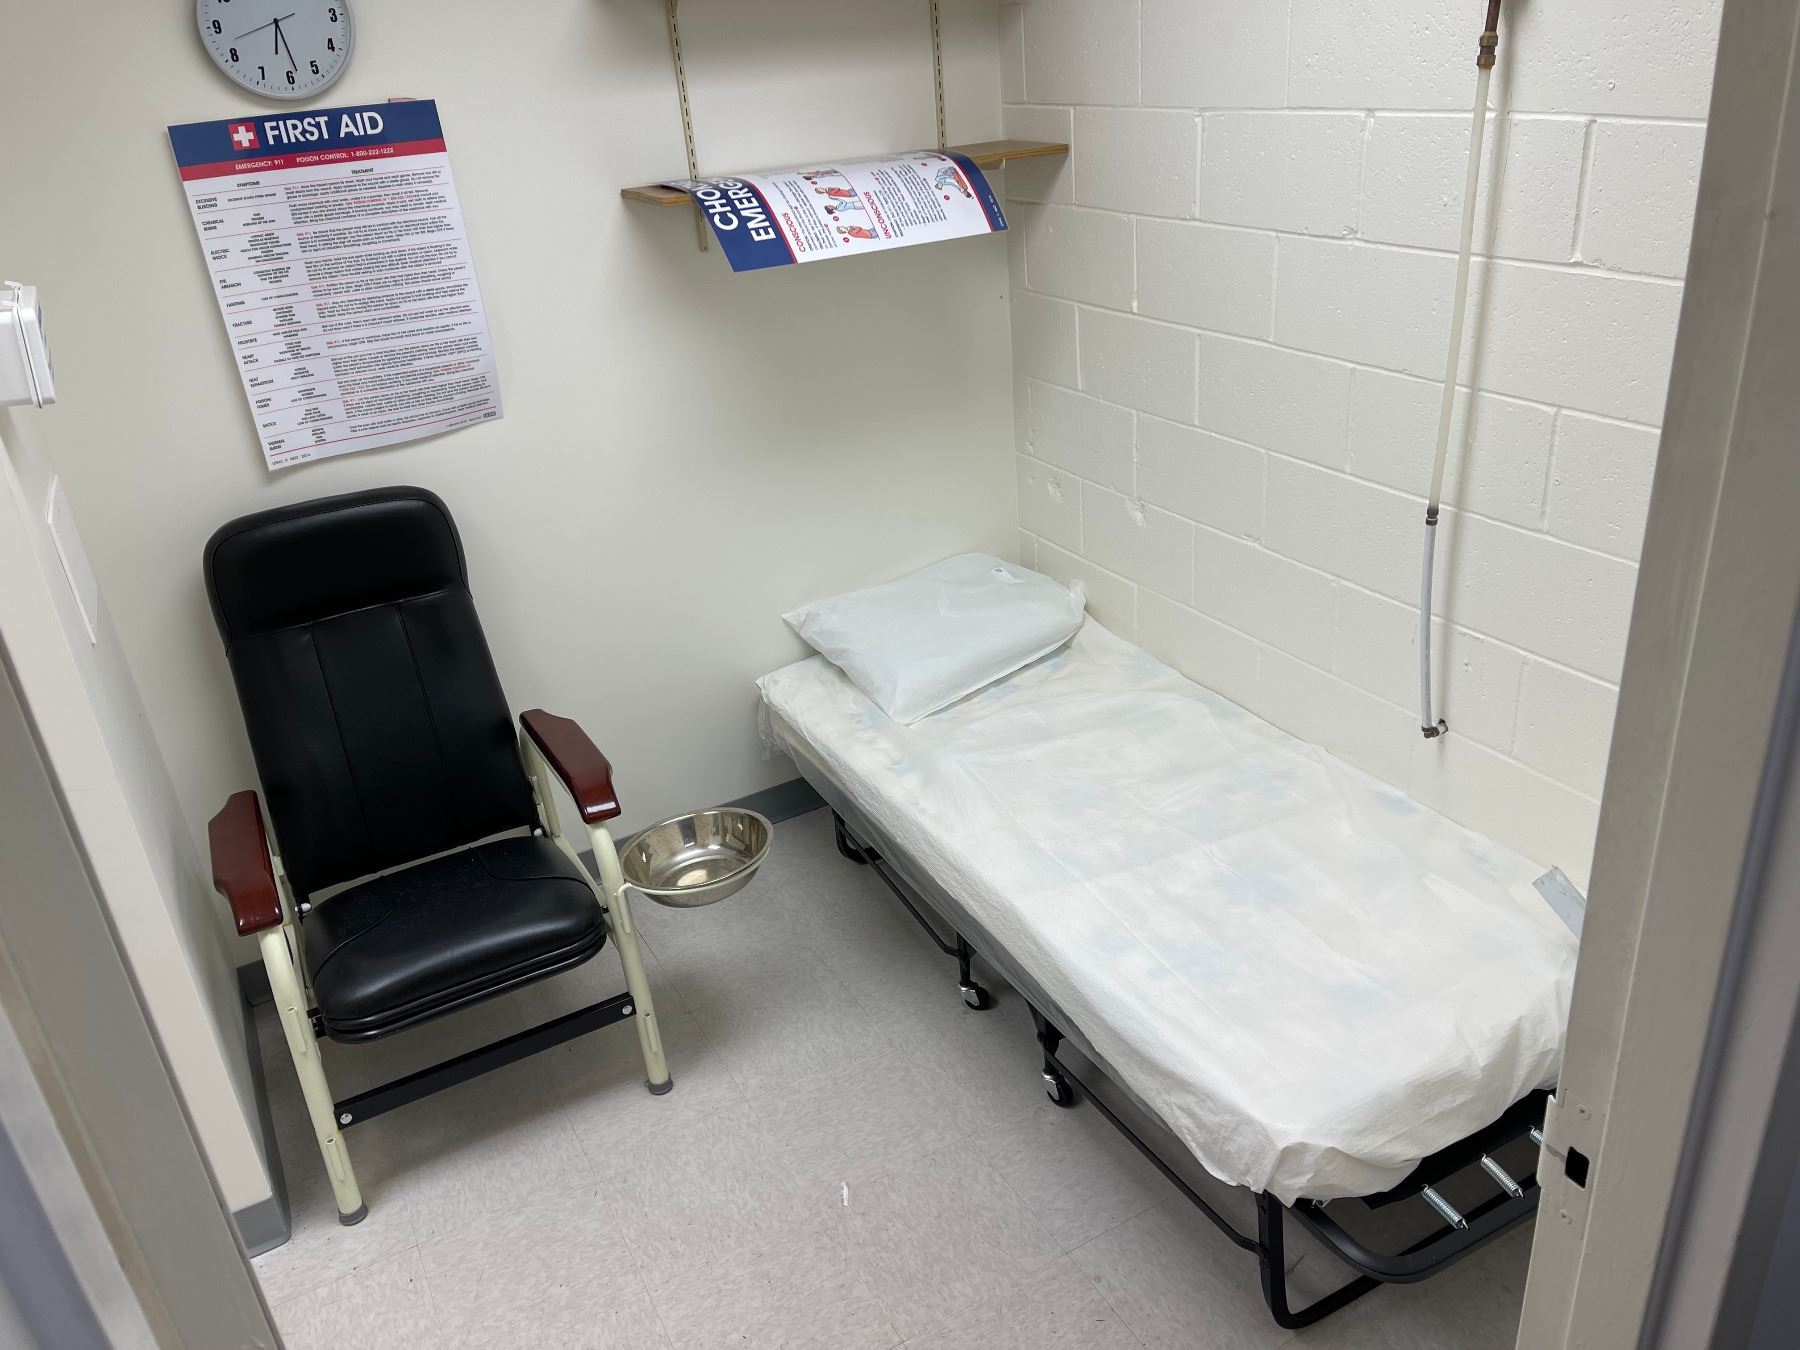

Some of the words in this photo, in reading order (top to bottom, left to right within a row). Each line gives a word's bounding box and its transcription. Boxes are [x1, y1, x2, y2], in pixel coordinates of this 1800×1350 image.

[328, 8, 338, 22] 3
[212, 19, 222, 34] 9
[327, 38, 335, 52] 4
[229, 48, 239, 62] 8
[258, 66, 266, 80] 7
[310, 60, 319, 74] 5
[286, 70, 295, 85] 6
[264, 116, 329, 144] FIRST
[339, 111, 384, 138] AID
[235, 160, 273, 170] EMERGENCY:
[296, 154, 318, 163] POISON
[863, 191, 892, 239] UNCONSCIOUS
[782, 212, 806, 252] CONSCIOUS
